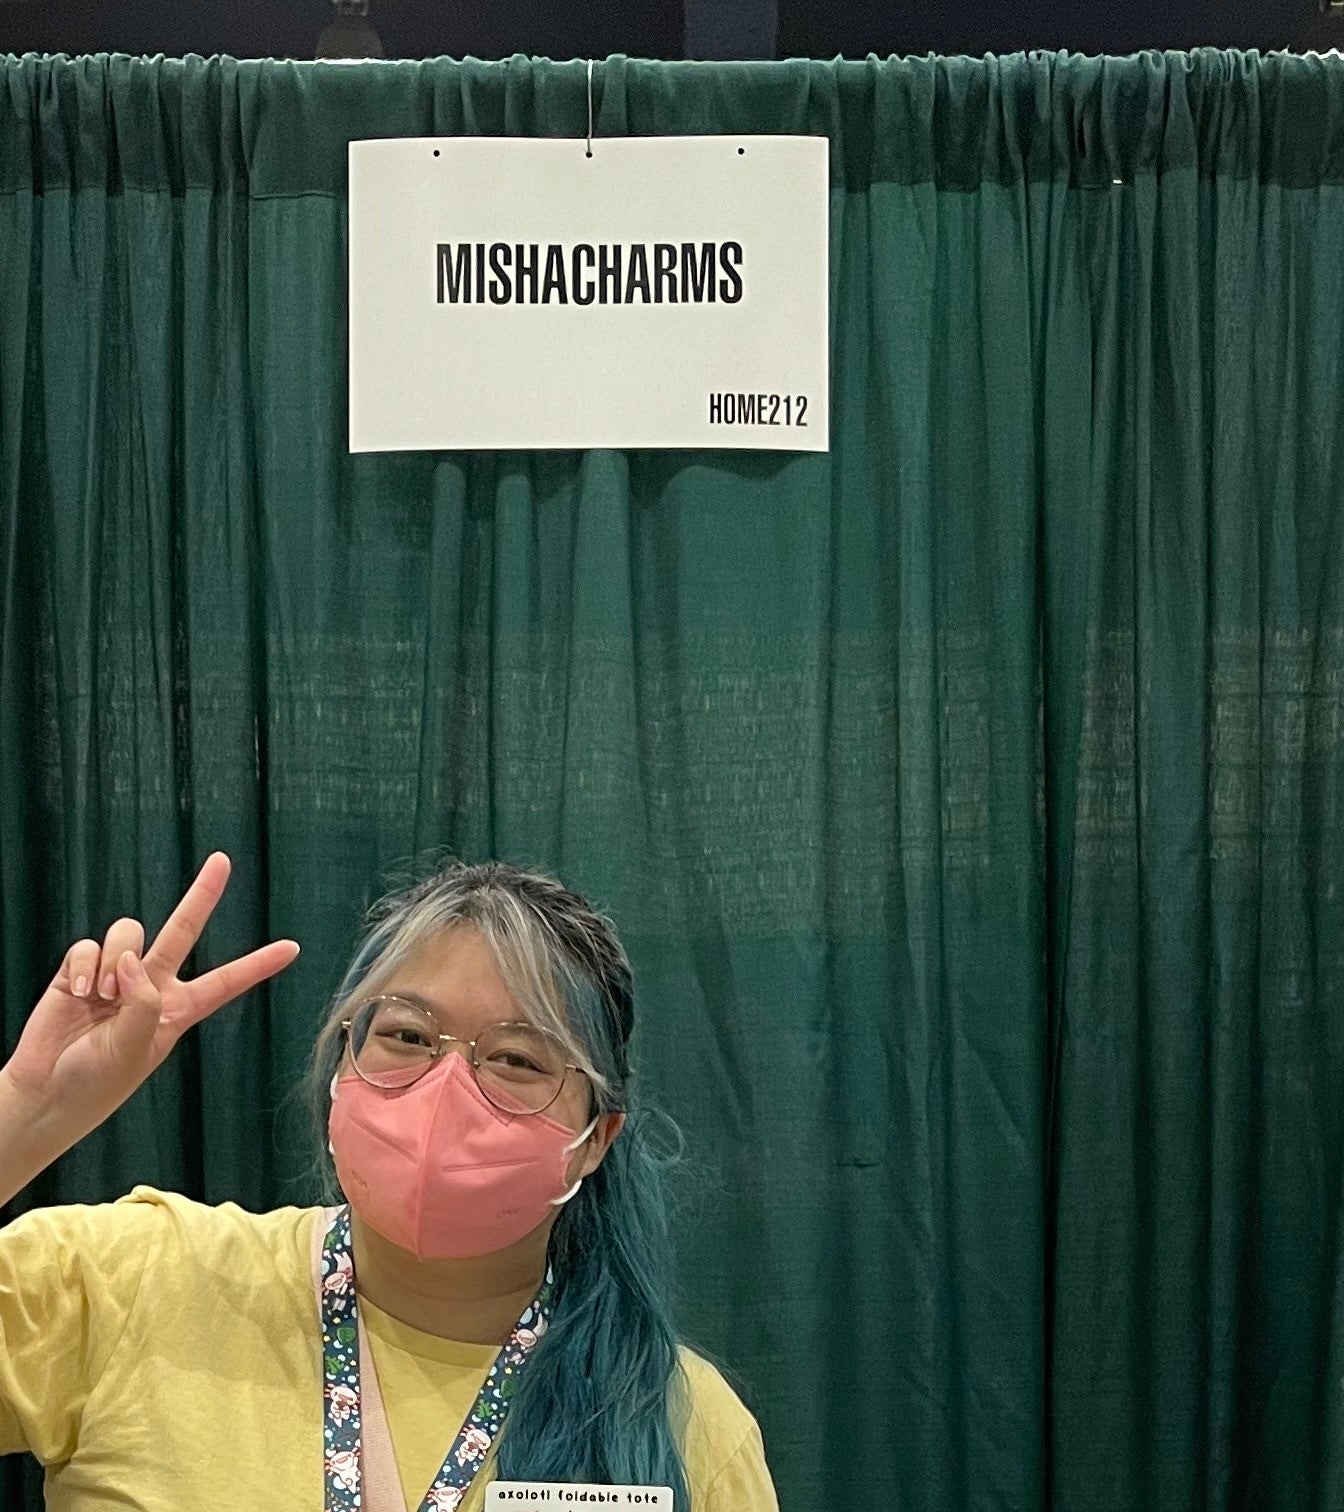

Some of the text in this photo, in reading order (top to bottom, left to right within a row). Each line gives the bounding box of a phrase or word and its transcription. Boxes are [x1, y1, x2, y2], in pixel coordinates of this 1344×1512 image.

[436, 241, 743, 305] MISHACHARMS
[709, 392, 808, 427] HOME212
[498, 1488, 659, 1504] axolotl foldable tote
